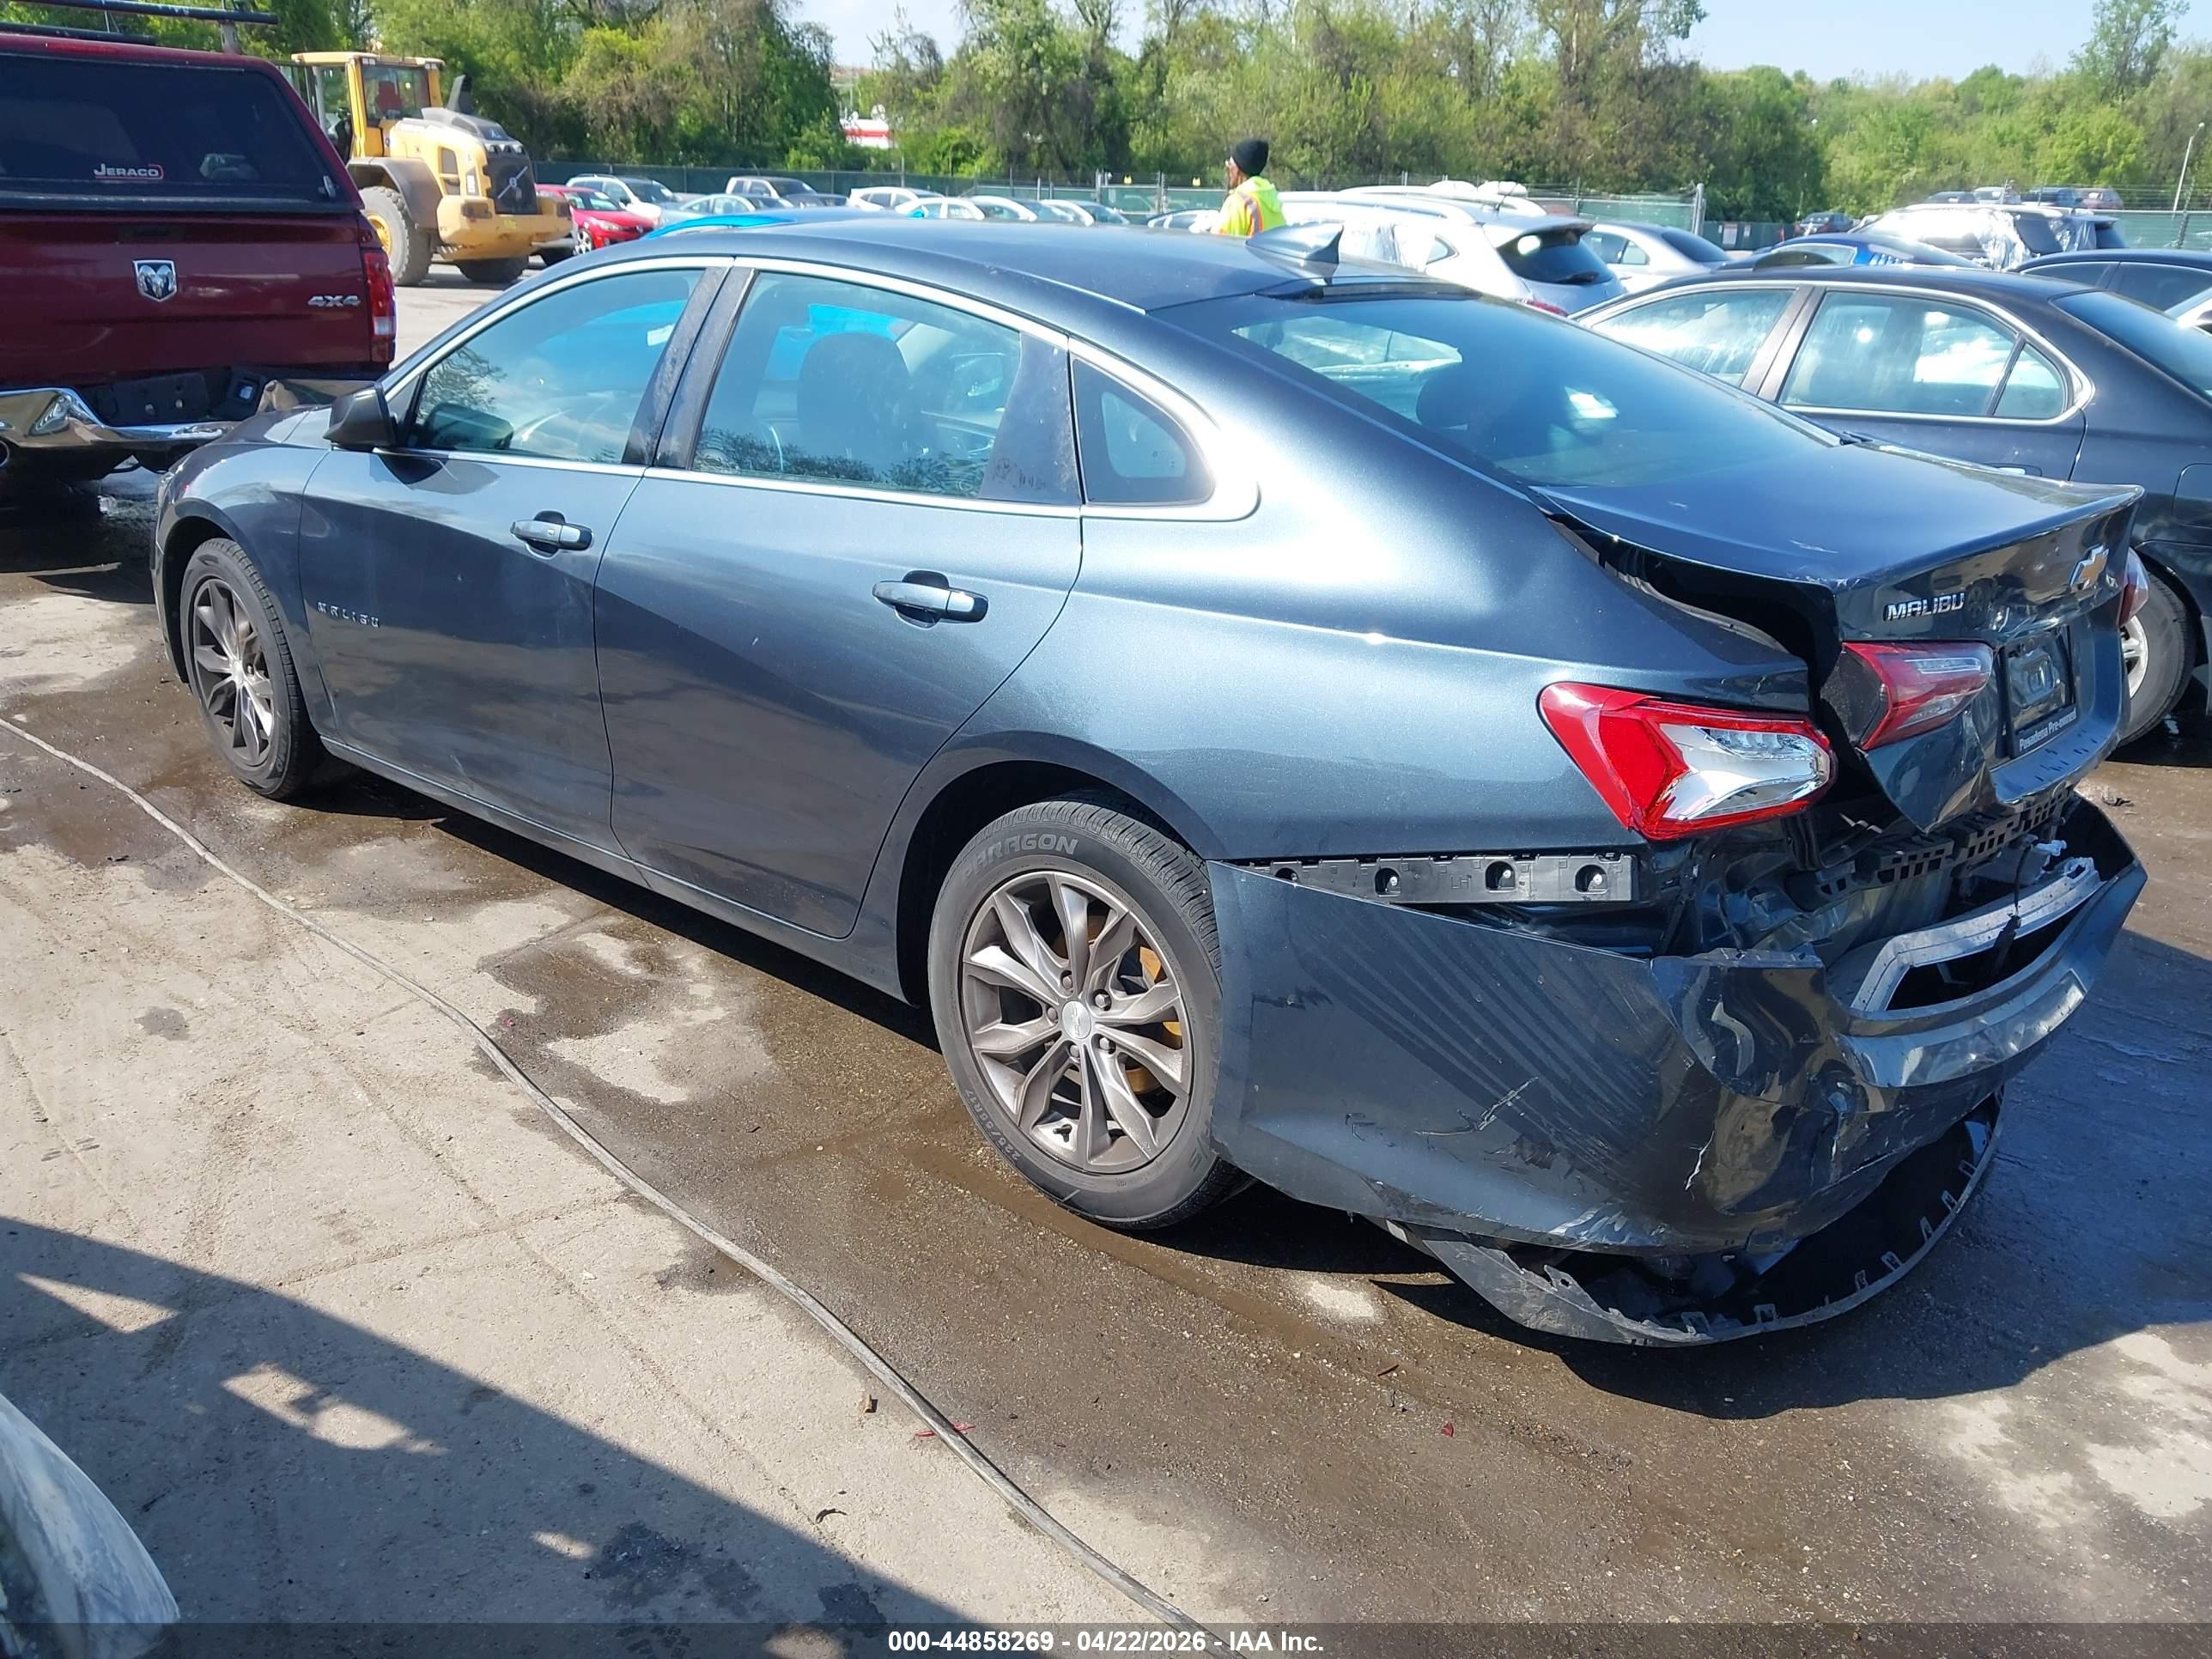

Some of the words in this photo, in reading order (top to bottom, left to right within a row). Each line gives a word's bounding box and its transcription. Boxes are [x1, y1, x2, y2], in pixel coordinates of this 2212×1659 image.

[1882, 592, 1965, 621] MALIBU
[2019, 726, 2049, 752] Pasadena
[962, 833, 1079, 880] PARAGON
[964, 1089, 1022, 1162] 225/55R17
